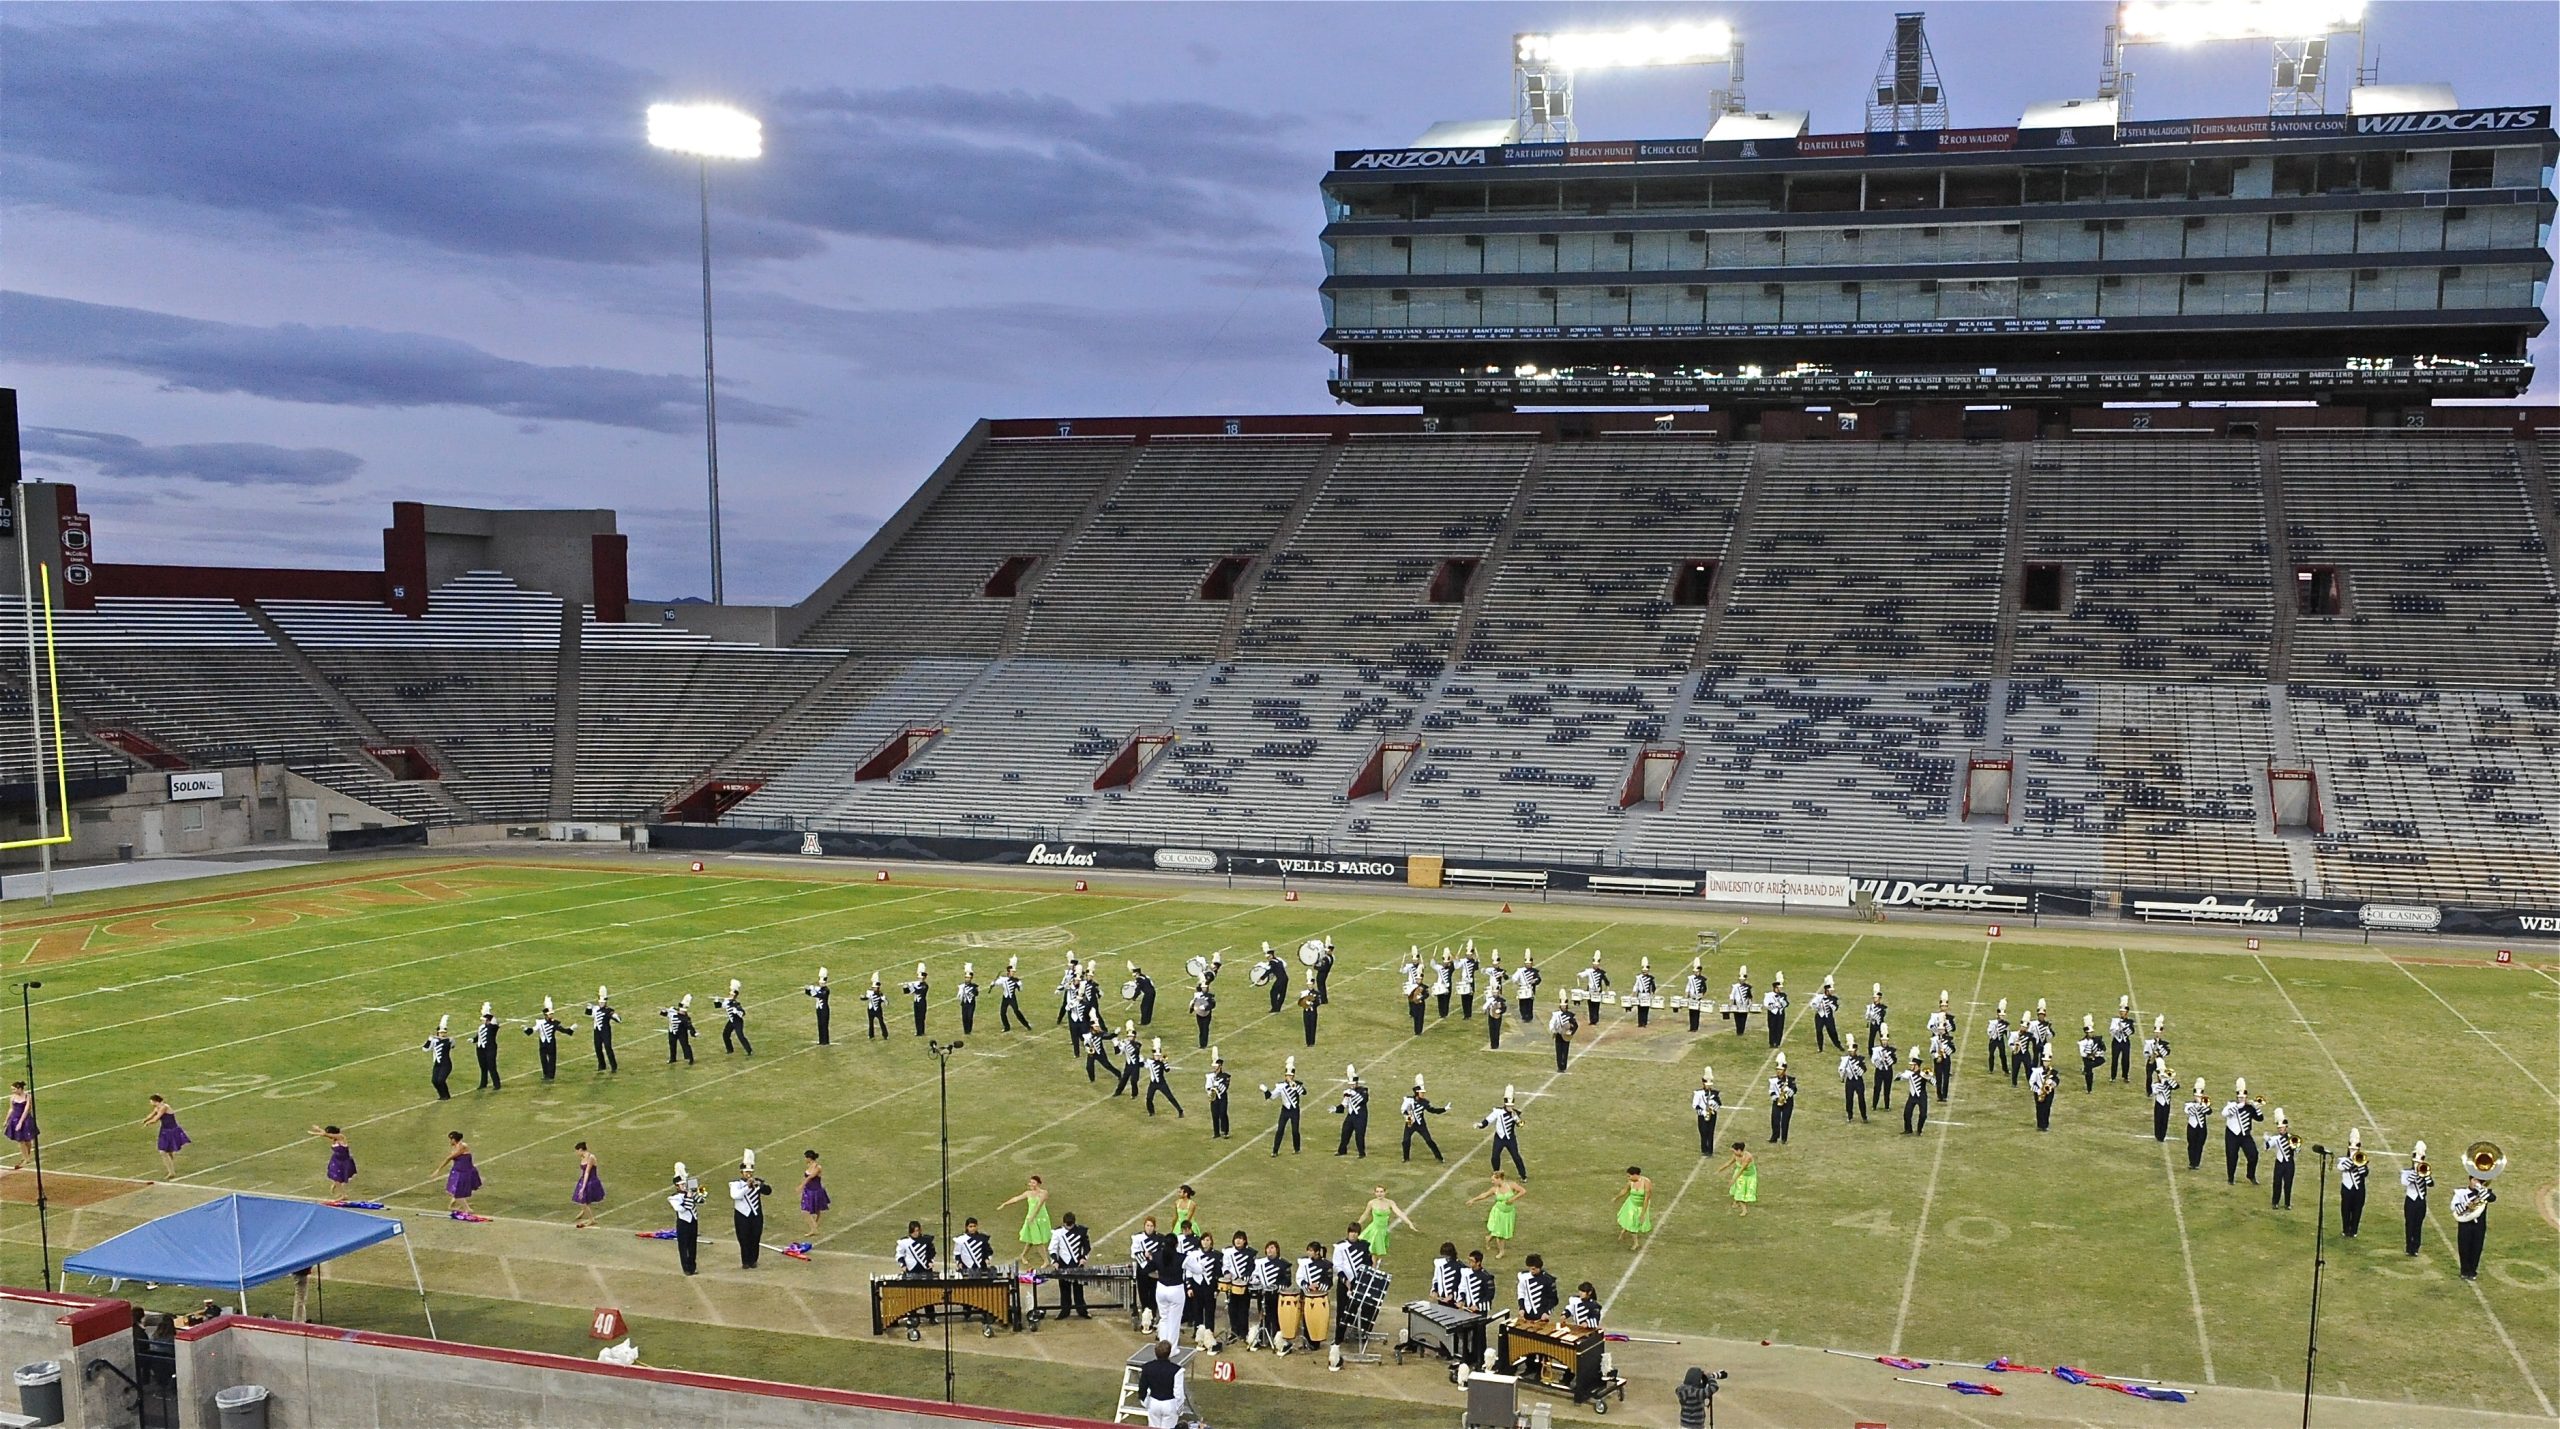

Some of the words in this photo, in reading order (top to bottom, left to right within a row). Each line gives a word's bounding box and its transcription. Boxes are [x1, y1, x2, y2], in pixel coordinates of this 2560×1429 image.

[2270, 121, 2276, 132] 5
[2277, 122, 2313, 132] ANTOINE
[2314, 121, 2344, 131] CASON
[2357, 110, 2540, 134] WILDCATS
[2128, 129, 2147, 138] STEVE
[2148, 127, 2192, 137] McLAUGHLIN
[2201, 125, 2225, 135] CHRIS
[2226, 123, 2268, 134] McALISTER
[1950, 136, 1967, 144] ROB
[1969, 134, 2009, 144] WALDROP
[1647, 145, 1675, 154] CHUCK
[1676, 144, 1698, 154] CECIL
[1804, 141, 1839, 150] DARRYLL
[1841, 140, 1865, 149] LEWIS
[1505, 149, 1514, 159] 22
[1531, 149, 1564, 158] LUPPINO
[1579, 148, 1602, 157] RICKY
[1604, 147, 1634, 156] HUNLEY
[1350, 149, 1487, 169] ARIZONA
[2361, 371, 2373, 379] JOE
[1841, 419, 1856, 430] 21
[2133, 418, 2149, 429] 22
[2407, 416, 2424, 428] 23
[1059, 427, 1070, 436] 17
[1226, 425, 1238, 434] 18
[1424, 423, 1436, 433] 19
[393, 588, 404, 597] 15
[665, 610, 675, 619] 16
[173, 781, 206, 792] SOLON
[1027, 844, 1097, 866] Bashas'
[1161, 854, 1175, 863] SOL
[1177, 854, 1211, 864] CASINOS
[1277, 859, 1335, 873] WELLS
[1337, 862, 1395, 876] FARGO
[1710, 880, 1752, 893] UNIVERSITY
[1754, 882, 1764, 893] OF
[1766, 881, 1802, 895] ARIZONA
[1804, 883, 1826, 895] BAND
[1829, 885, 1845, 897] DAY
[2389, 912, 2433, 921] CASINOS
[2498, 951, 2509, 962] 20
[1830, 1208, 2011, 1247] 40
[594, 1313, 614, 1334] 40
[1214, 1362, 1232, 1381] 50
